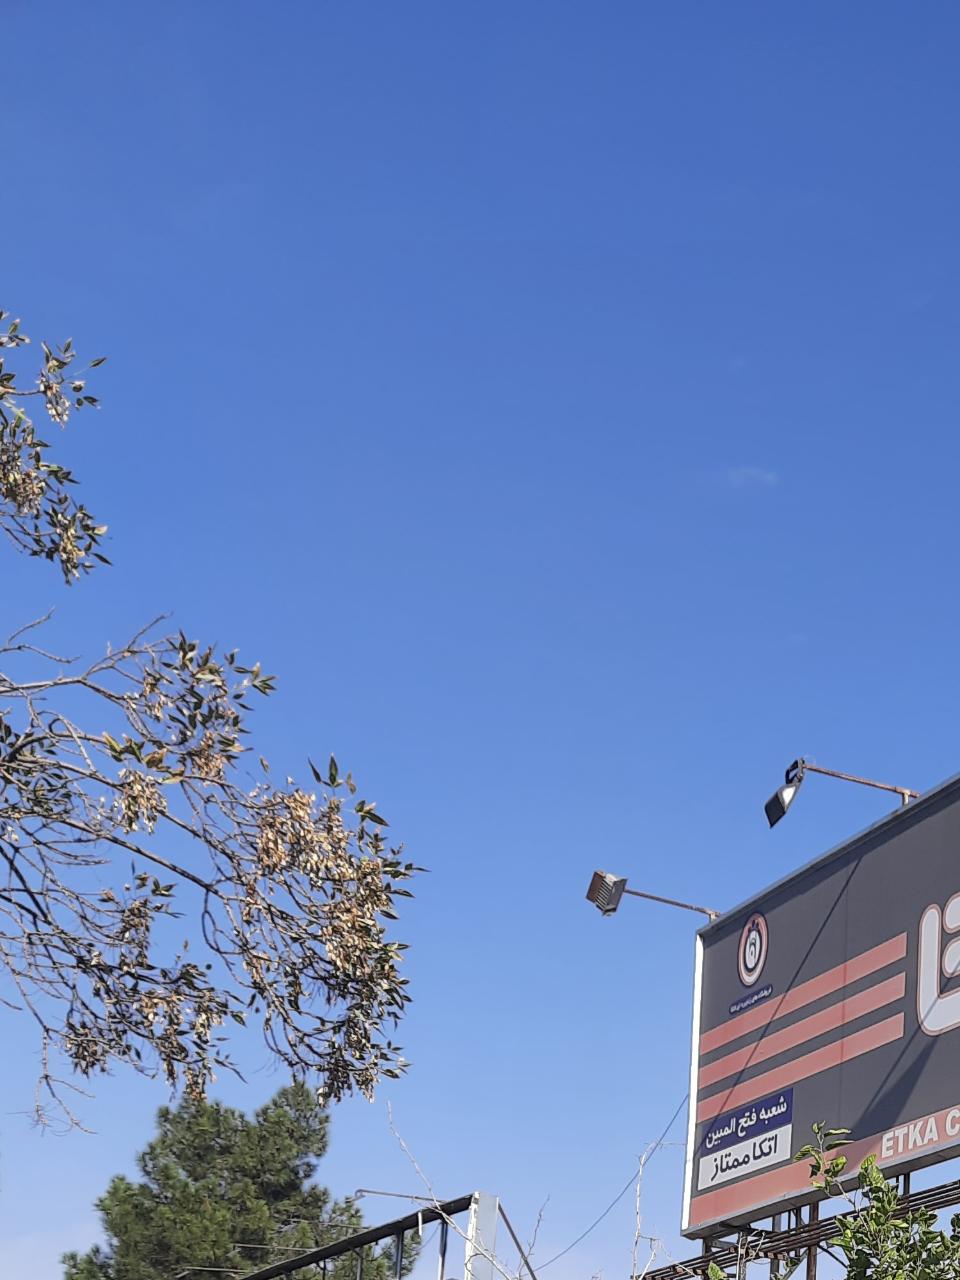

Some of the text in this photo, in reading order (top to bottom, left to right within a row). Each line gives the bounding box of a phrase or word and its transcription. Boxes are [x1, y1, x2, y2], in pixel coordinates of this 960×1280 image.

[705, 1095, 788, 1149] شعبه فتح المبین
[881, 1120, 939, 1159] ETKA
[710, 1133, 779, 1182] اتکا ممتاز
